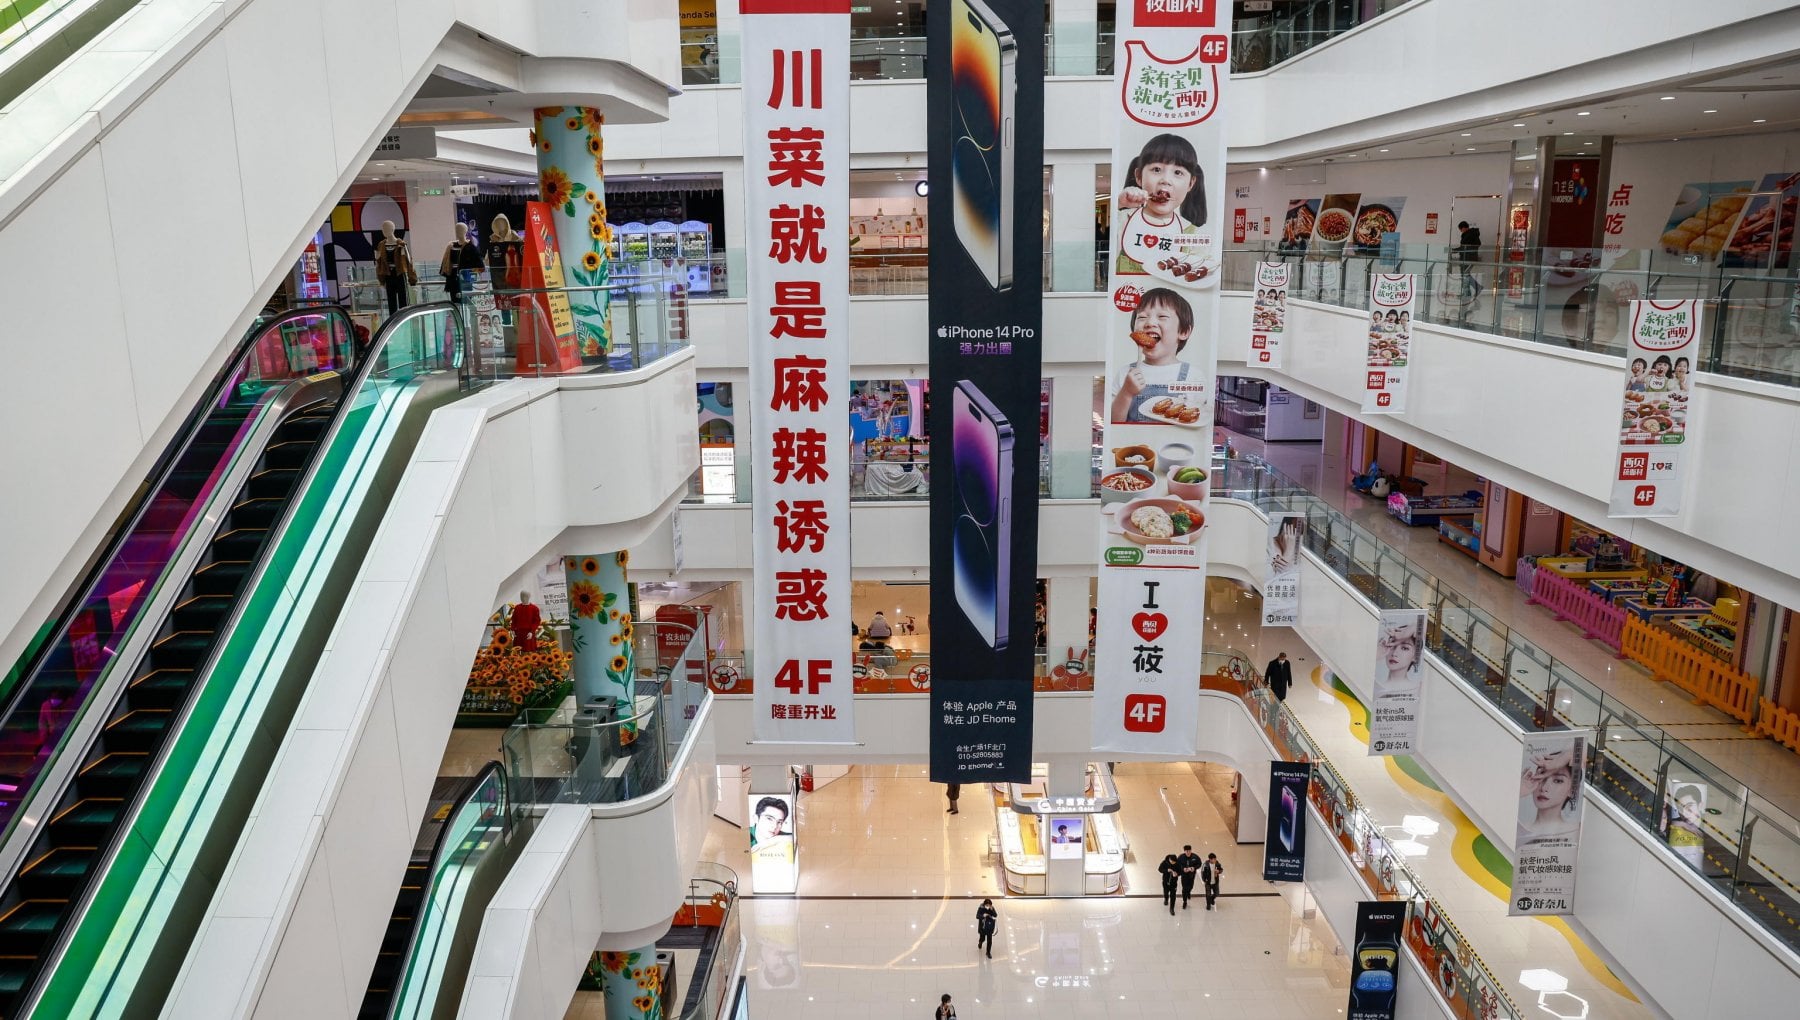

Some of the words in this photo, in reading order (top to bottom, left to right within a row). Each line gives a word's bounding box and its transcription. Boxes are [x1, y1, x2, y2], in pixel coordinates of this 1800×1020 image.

[1203, 41, 1225, 56] 4F
[1140, 65, 1202, 90] 家有宝贝
[1132, 86, 1207, 110] 就吃西贝
[1609, 184, 1633, 206] 点
[1604, 213, 1626, 234] 吃
[1134, 234, 1143, 246] I
[1645, 311, 1686, 326] 家有宝贝
[766, 48, 829, 622] 川菜就是麻辣诱惑
[948, 325, 993, 338] iPhone
[995, 326, 1010, 338] 14
[1012, 326, 1034, 338] Pro
[1639, 325, 1688, 340] 就吃西贝
[960, 342, 1012, 354] 强力出圈
[1379, 395, 1389, 404] 4F
[1623, 457, 1644, 468] 西贝
[1636, 490, 1654, 502] 4F
[1142, 581, 1160, 608] I
[1132, 645, 1164, 674] 莜
[774, 659, 832, 695] 4F
[771, 704, 836, 720] 隆重开业
[943, 701, 963, 711] 体验
[966, 701, 993, 712] Apple
[996, 700, 1017, 711] 产品
[1129, 703, 1161, 722] 4F
[943, 714, 964, 725] 就在
[967, 716, 980, 724] JD
[982, 714, 1016, 723] Ehome
[1520, 855, 1559, 865] 秋冬ins风
[1533, 898, 1567, 909] 舒奈儿
